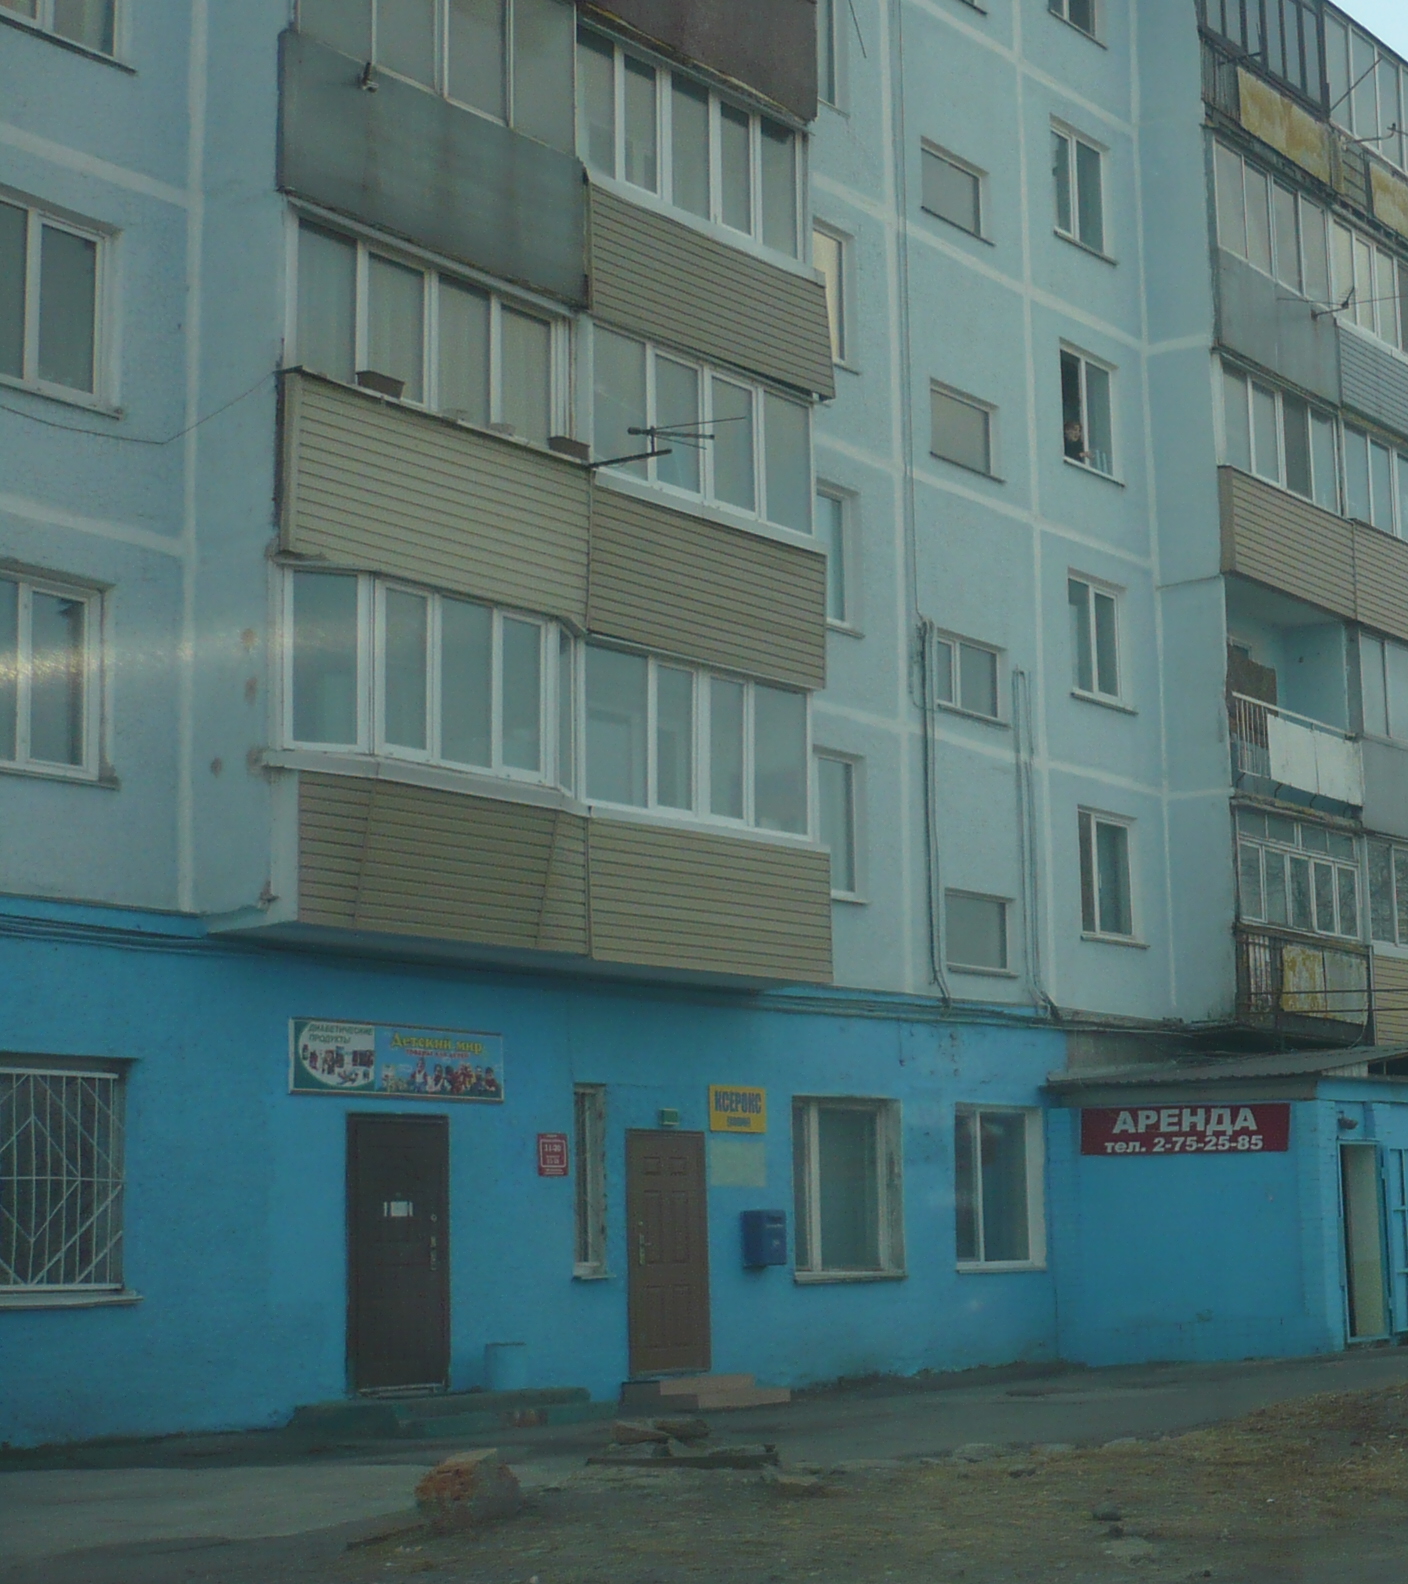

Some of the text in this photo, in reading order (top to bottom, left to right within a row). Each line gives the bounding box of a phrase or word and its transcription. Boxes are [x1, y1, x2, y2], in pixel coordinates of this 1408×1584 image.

[309, 1034, 351, 1044] ПРОДУКТЫ
[391, 1031, 482, 1054] Детский мир
[715, 1090, 762, 1114] КСЕРОКС
[1112, 1107, 1258, 1136] АРЕНДА
[1104, 1135, 1264, 1153] тел. 2-75-25-85
